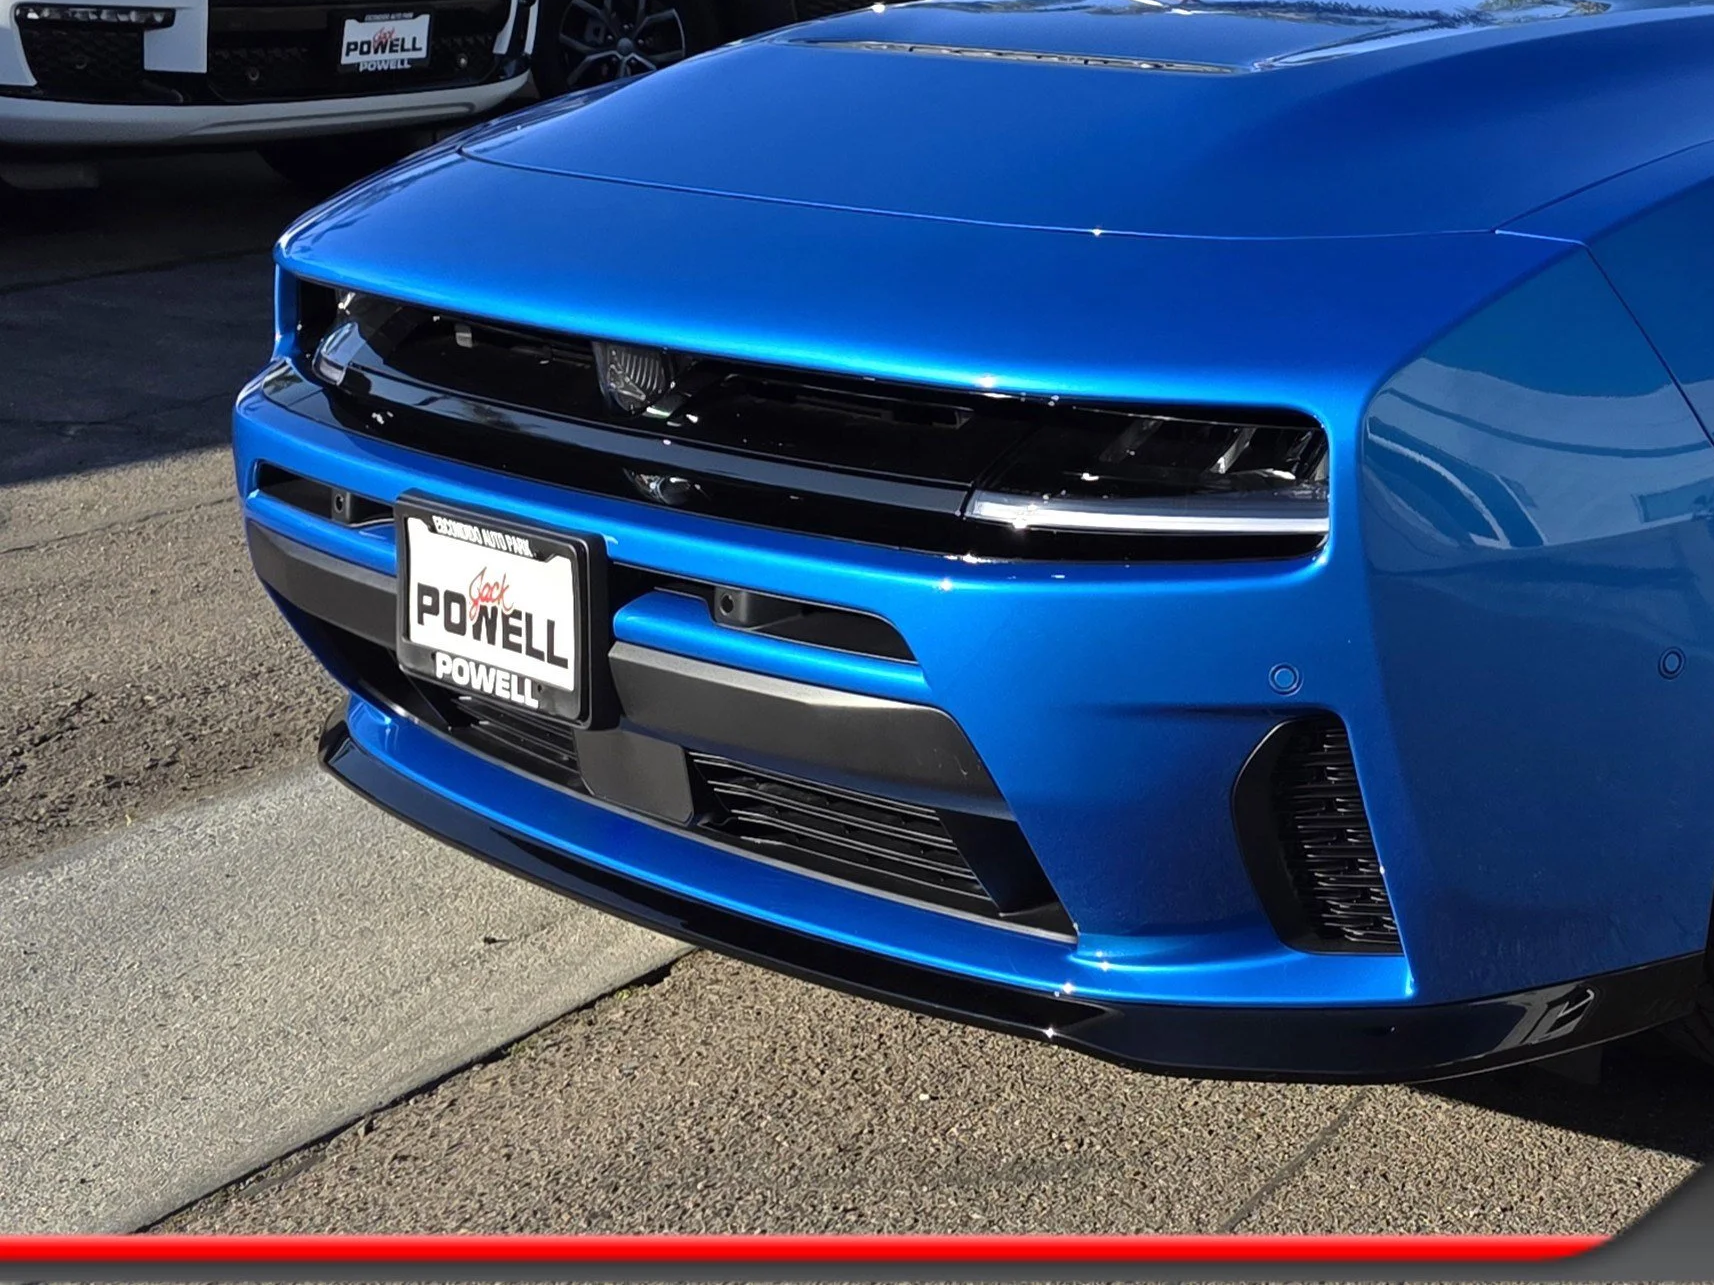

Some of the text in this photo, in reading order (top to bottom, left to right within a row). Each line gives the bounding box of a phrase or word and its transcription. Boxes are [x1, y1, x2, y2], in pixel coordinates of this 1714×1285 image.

[345, 36, 422, 57] POWELL
[359, 59, 412, 72] POWELL
[481, 528, 508, 551] AUTO
[504, 534, 534, 558] PARK
[469, 566, 513, 622] Jack
[417, 582, 569, 670] POWELL
[435, 651, 540, 709] POWELL
